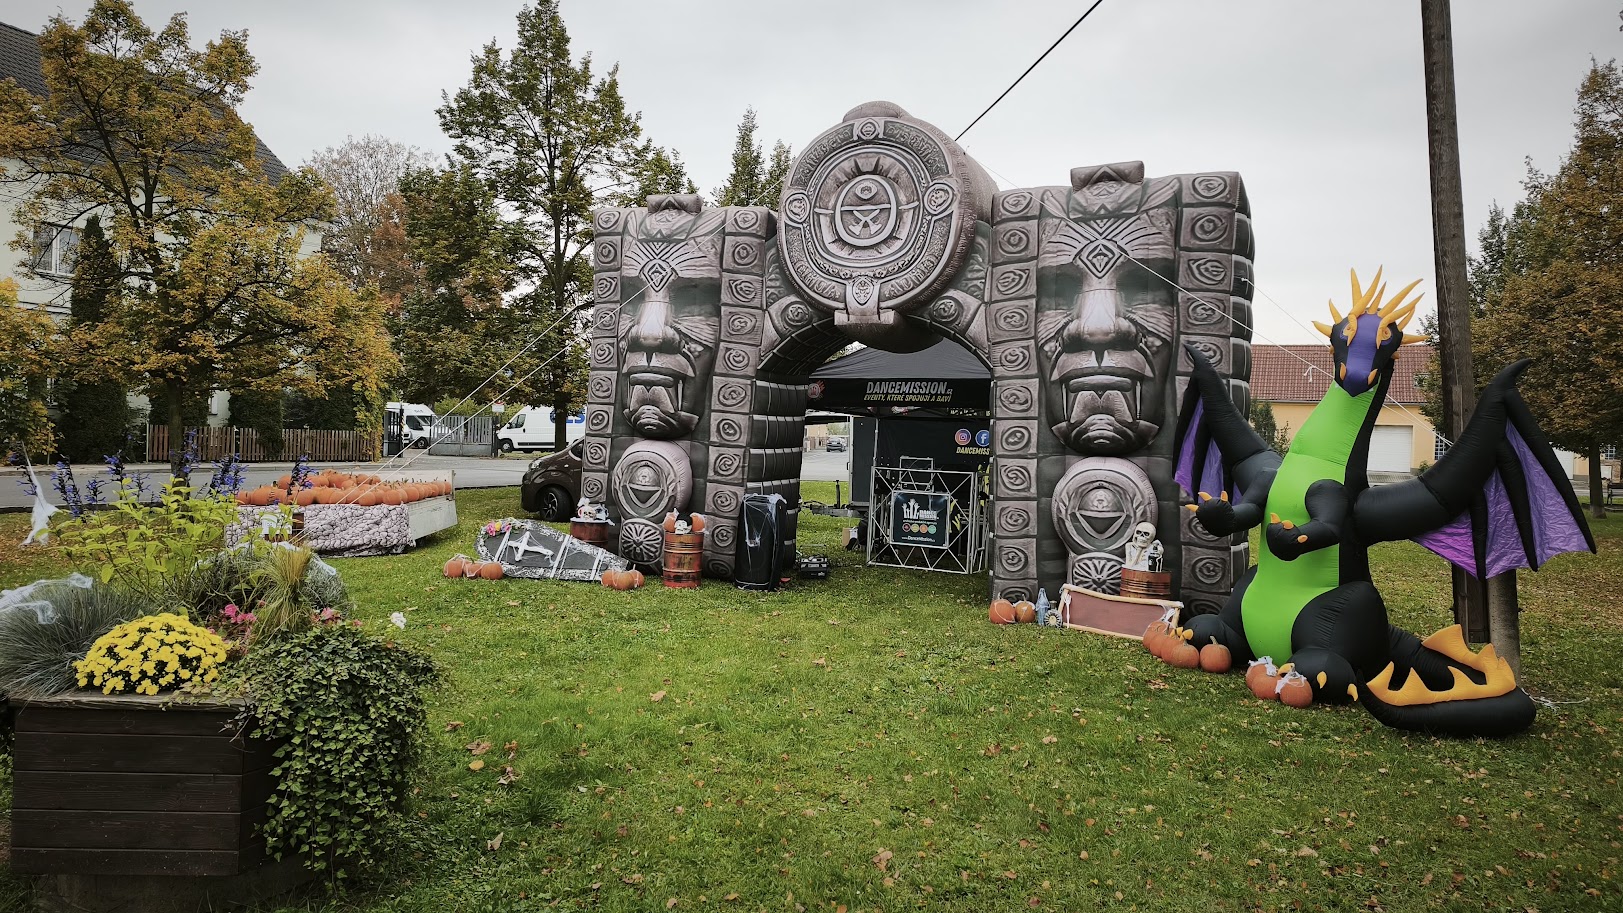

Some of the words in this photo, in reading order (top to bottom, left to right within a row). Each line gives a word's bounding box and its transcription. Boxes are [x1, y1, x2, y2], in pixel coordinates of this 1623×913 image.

[864, 394, 885, 402] EVENTY,
[887, 393, 905, 401] KTERÉ
[905, 393, 931, 402] SPOJUJÍ
